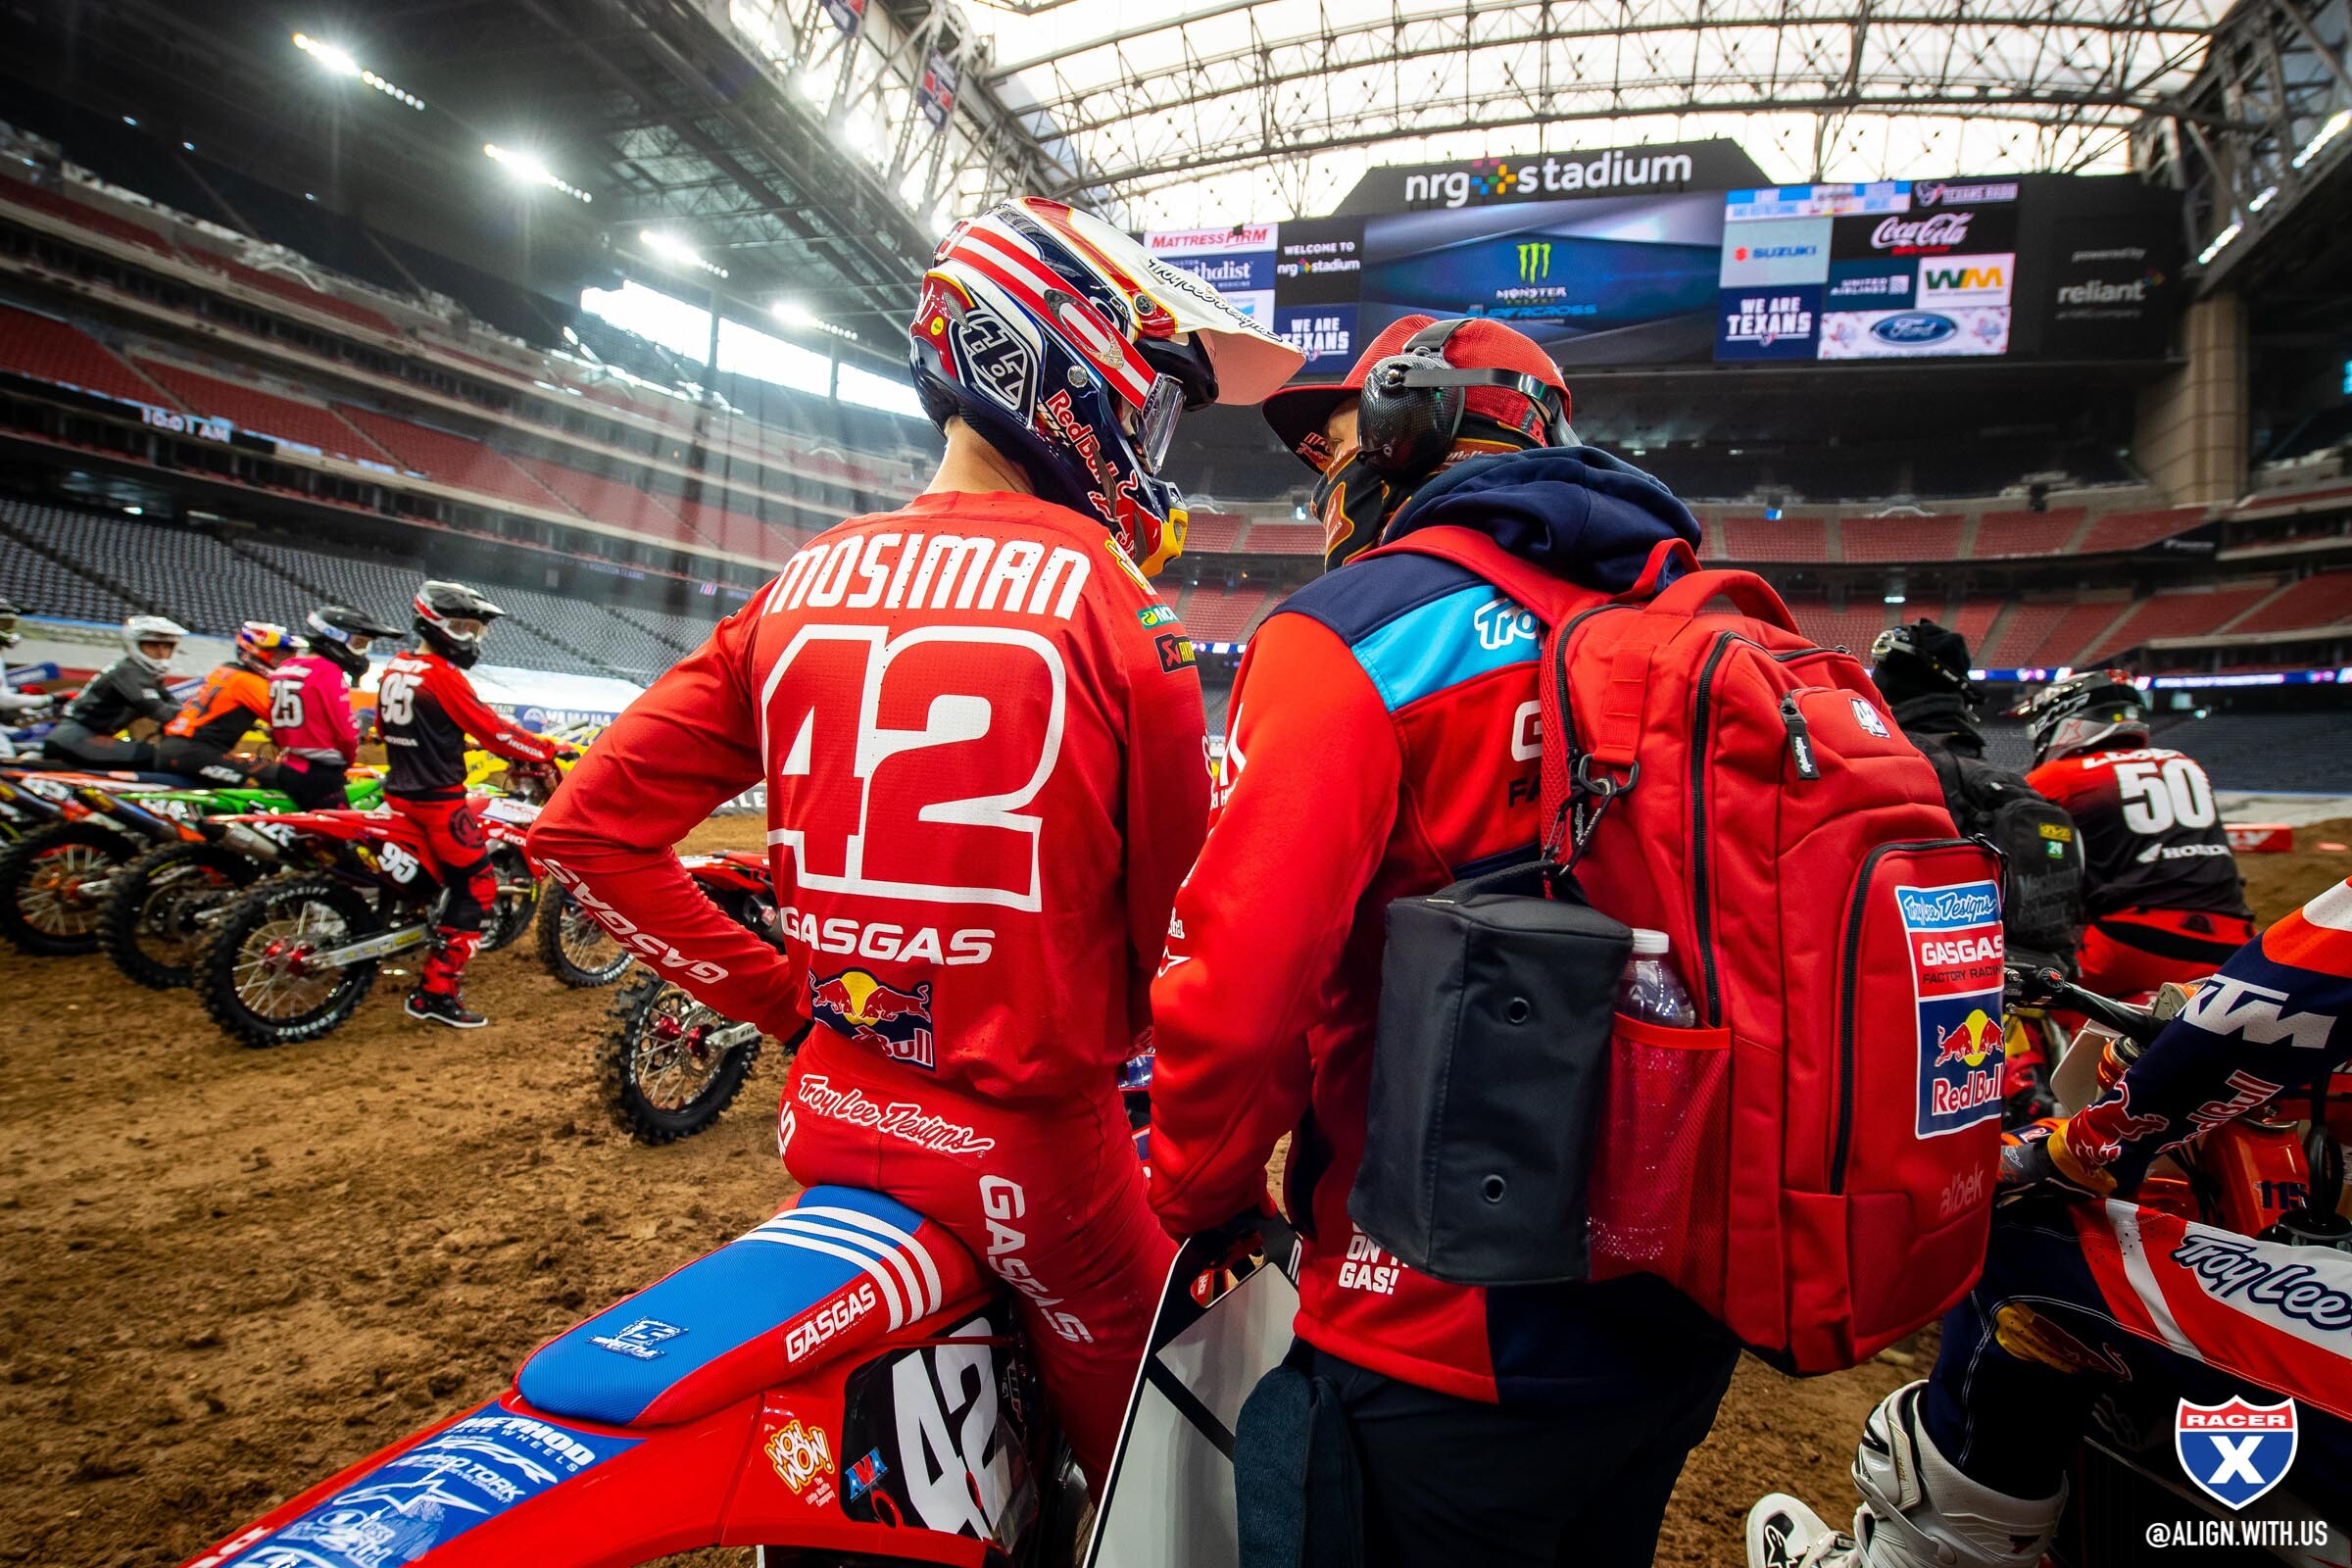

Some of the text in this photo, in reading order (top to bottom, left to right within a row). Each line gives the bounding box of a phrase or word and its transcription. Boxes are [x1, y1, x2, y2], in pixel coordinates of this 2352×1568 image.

[1405, 150, 1692, 208] nrg stadium
[1277, 259, 1360, 277] nrg stadium
[1284, 241, 1355, 256] WELCOME TO
[1752, 245, 1817, 260] SUZUKI
[1495, 286, 1568, 300] MONSTER
[1926, 268, 2003, 289] WM
[2057, 279, 2146, 304] reliant
[1292, 318, 1341, 332] WE ARE
[1727, 312, 1812, 335] TEXANS
[1740, 297, 1801, 314] WE ARE
[1281, 331, 1349, 351] TEXANS
[1889, 318, 1936, 338] Ford
[1046, 388, 1094, 443] Red
[761, 533, 1091, 620] MOSIMAN
[1474, 598, 1544, 651] Tro
[270, 679, 304, 728] 25
[380, 672, 424, 725] 95
[509, 740, 546, 760] HONDA
[761, 624, 1066, 912] 42
[2114, 759, 2216, 834] 50
[377, 842, 420, 883] 95
[1936, 893, 1997, 922] Designs
[780, 906, 996, 966] GASGAS
[1922, 935, 2002, 966] GASGAS
[1923, 964, 2002, 984] FACTORY RACIN
[2176, 973, 2337, 1050] KTM
[1932, 1062, 2004, 1115] Red Bull
[2197, 1069, 2284, 1117] Bull
[798, 1074, 996, 1154] Troy Lee Designs
[980, 1176, 1096, 1344] GASGAS
[1347, 1235, 1380, 1264] ON
[1339, 1262, 1400, 1295] GAS!
[2170, 1233, 2352, 1331] Troy Lee
[785, 1282, 877, 1363] GASGAS
[453, 1416, 596, 1466] METHOD
[501, 1429, 579, 1473] WHEELS
[767, 1423, 804, 1466] WOW
[892, 1316, 1000, 1543] 42
